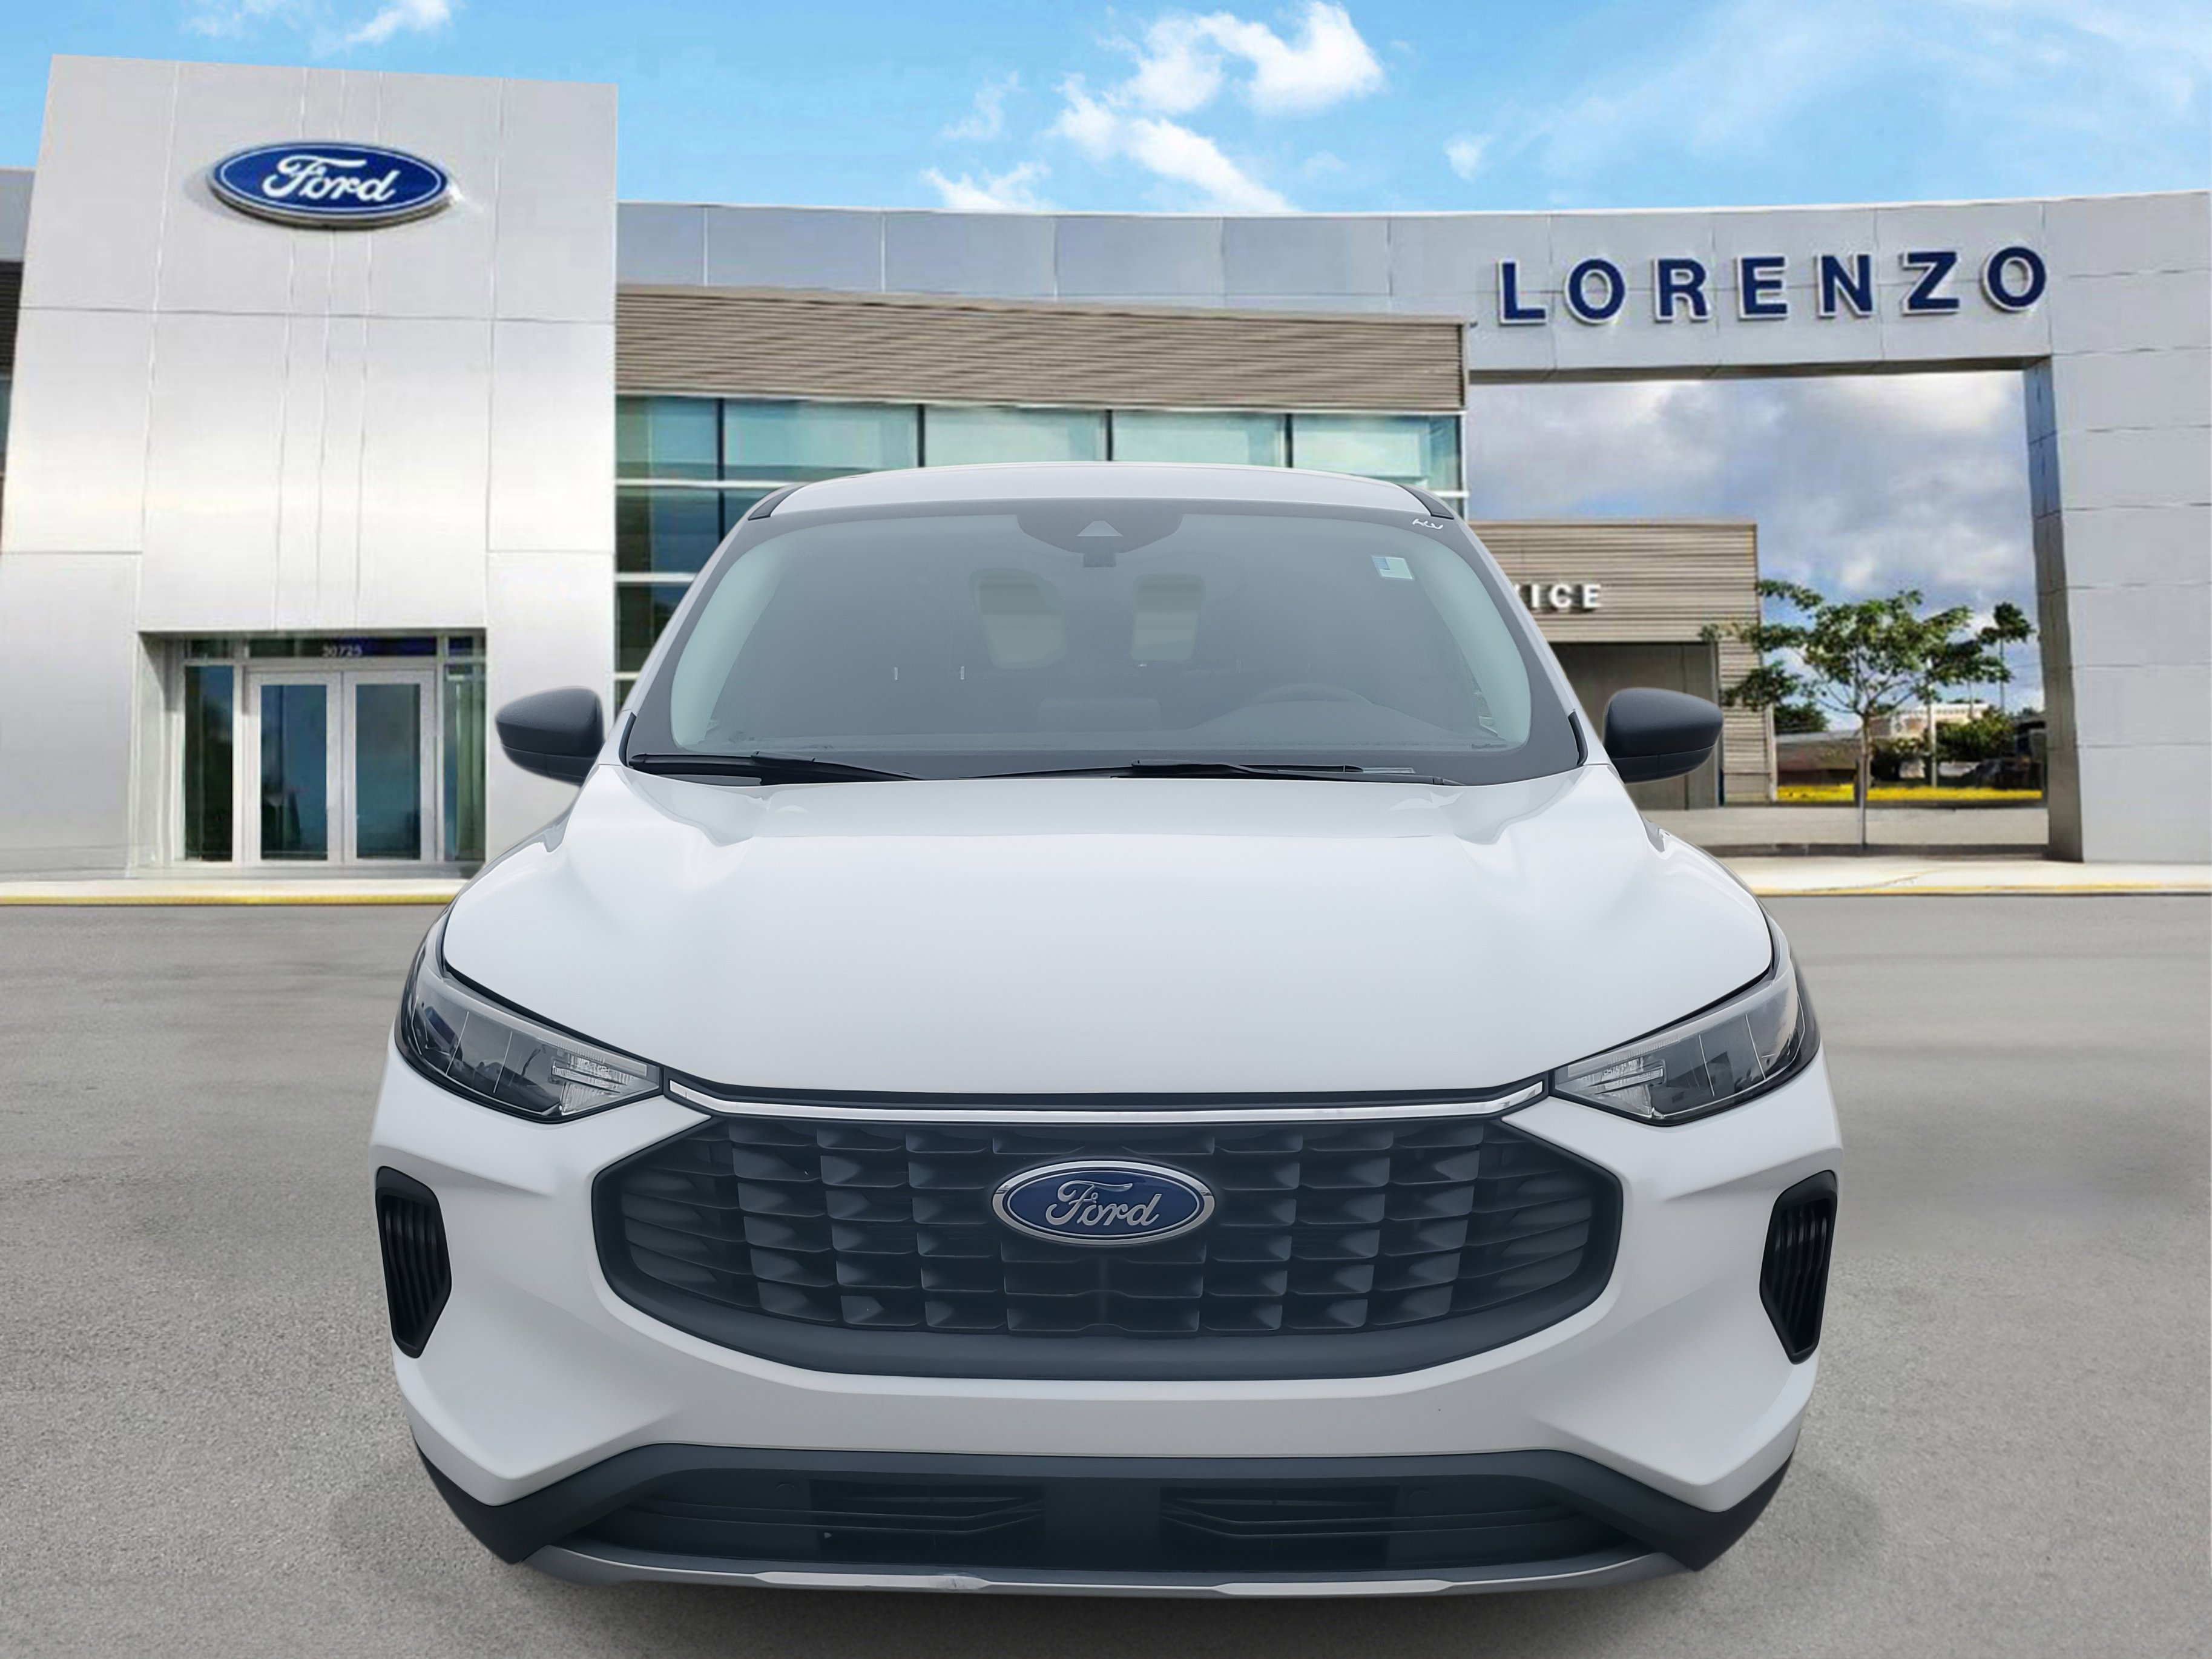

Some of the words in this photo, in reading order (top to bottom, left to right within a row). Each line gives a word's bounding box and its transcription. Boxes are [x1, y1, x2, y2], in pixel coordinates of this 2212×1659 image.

[262, 154, 400, 202] Ford
[1497, 246, 2047, 325] LORENZO
[1045, 1179, 1162, 1227] Ford
